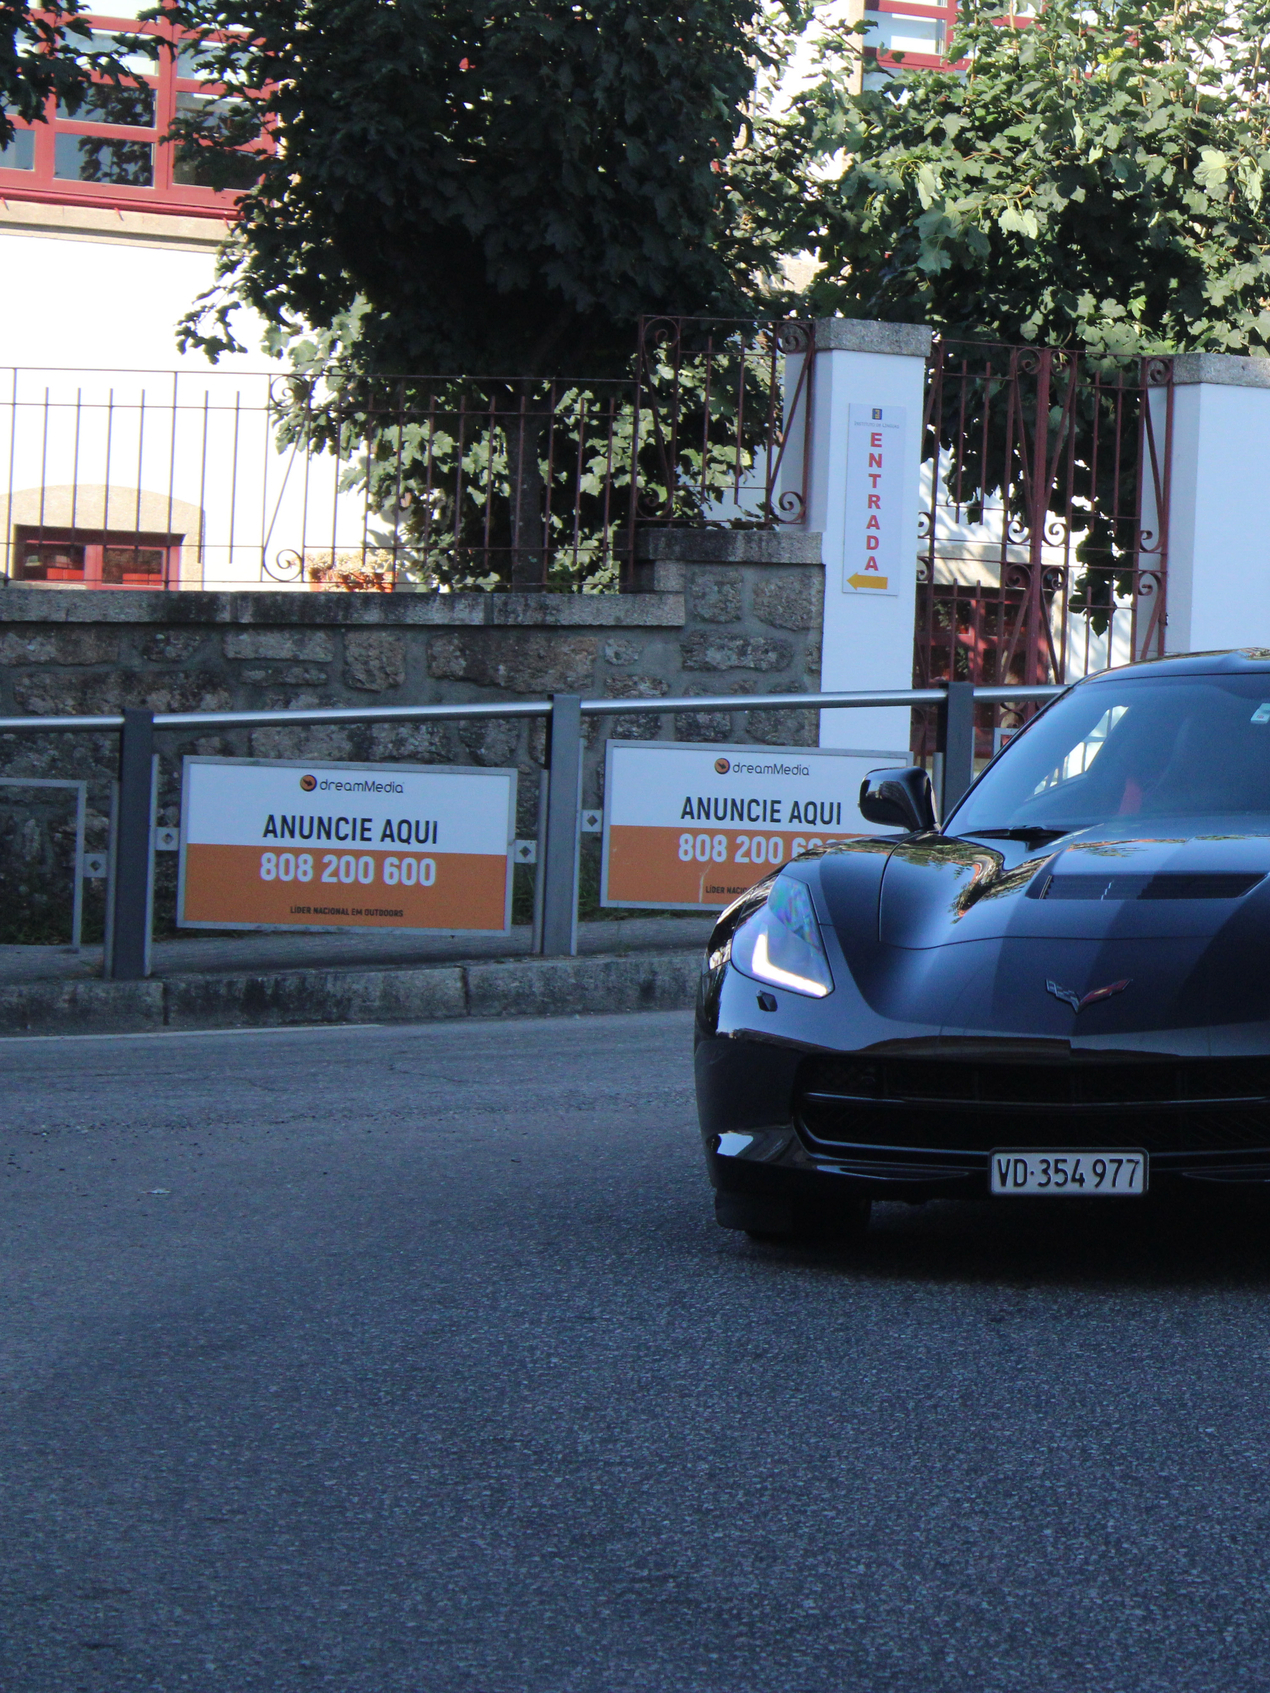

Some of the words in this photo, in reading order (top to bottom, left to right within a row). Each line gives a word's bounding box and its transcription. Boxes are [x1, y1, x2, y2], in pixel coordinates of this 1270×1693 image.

[864, 432, 883, 572] ENTRADA
[732, 762, 810, 776] dreamMedia
[319, 778, 404, 794] dreamMedia
[680, 796, 781, 823] ANUNCIE
[788, 800, 841, 826] AQUI
[262, 813, 373, 842] ANUNCIE
[380, 818, 438, 845] AQUI
[678, 833, 727, 863] 808
[734, 835, 783, 864] 200
[260, 852, 313, 882] 808
[321, 854, 374, 884] 200
[382, 857, 436, 887] 600
[313, 907, 350, 916] NACIONAL
[351, 908, 363, 916] EM
[364, 909, 404, 917] OUTDOORS
